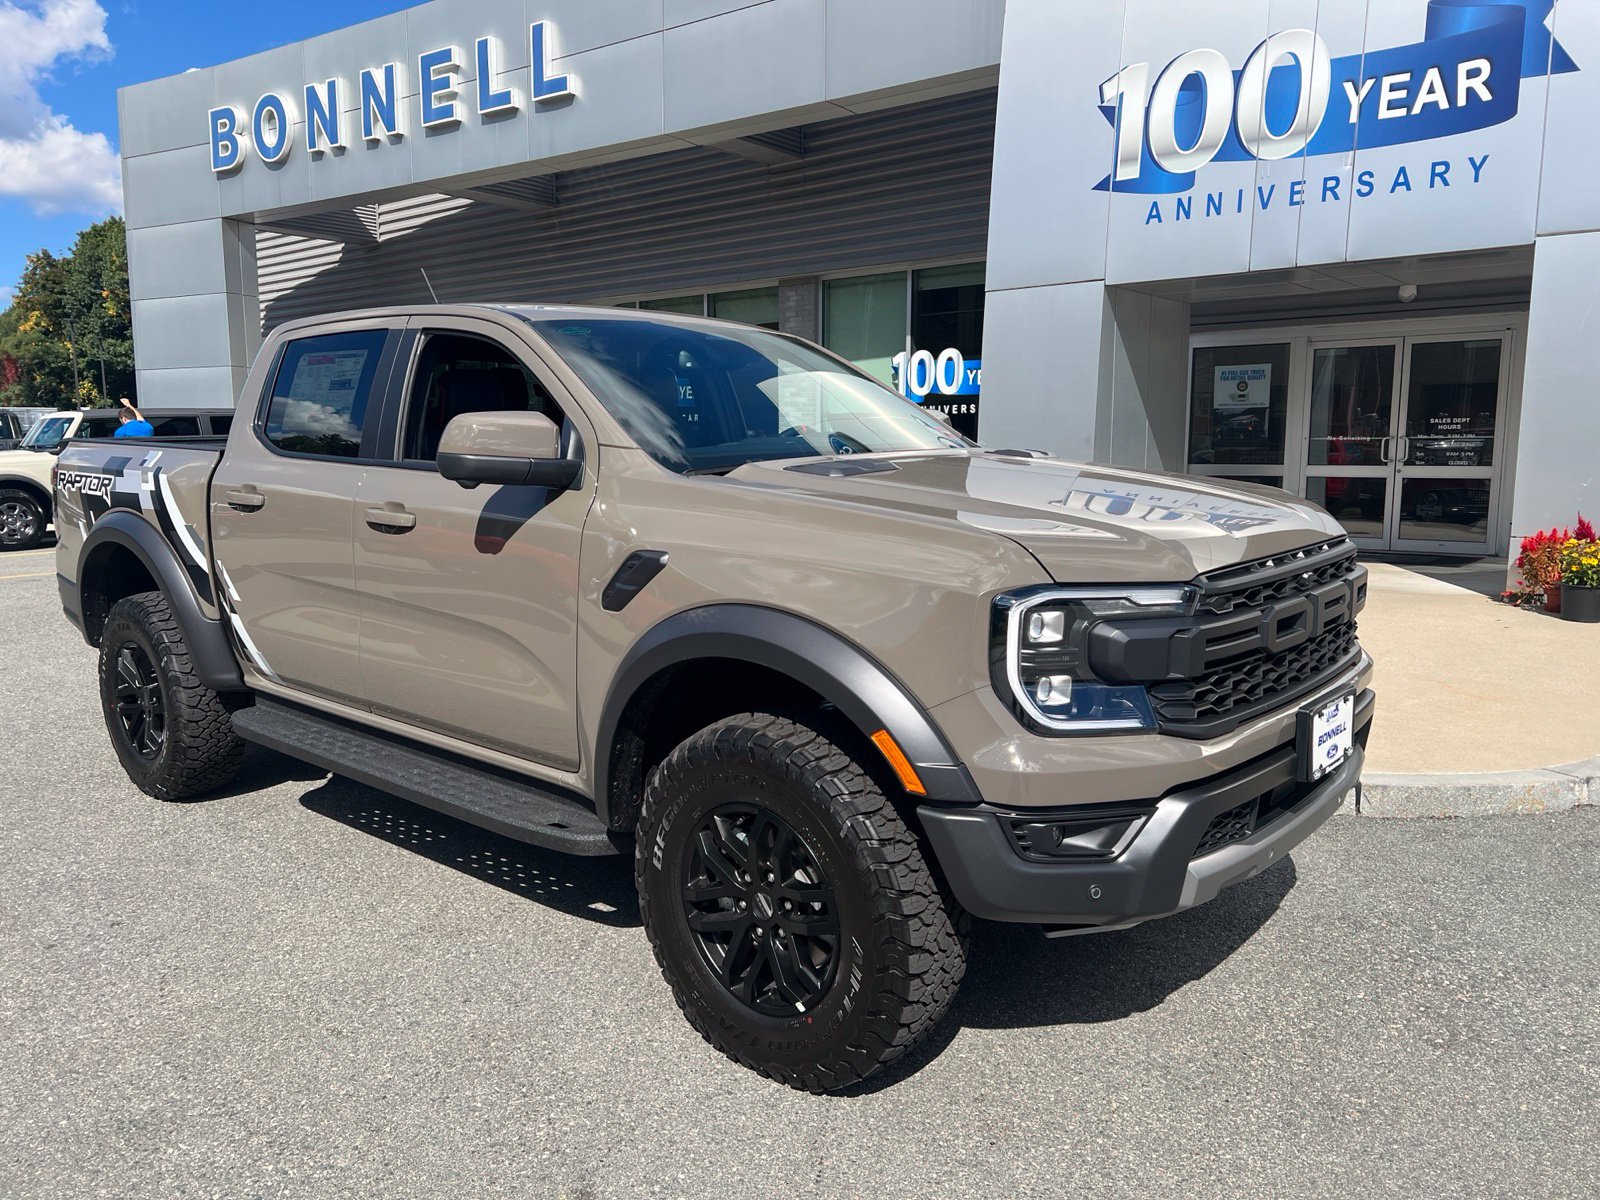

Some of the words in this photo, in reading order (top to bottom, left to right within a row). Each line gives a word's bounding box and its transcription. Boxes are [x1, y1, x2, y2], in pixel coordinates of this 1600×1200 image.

[208, 19, 576, 172] BONNELL
[1100, 28, 1331, 182] 100
[1342, 57, 1493, 124] YEAR
[1145, 154, 1490, 226] ANNIVERSARY
[892, 347, 964, 396] 100
[57, 471, 116, 507] RAPTOR
[1196, 565, 1368, 676] FORD
[1318, 722, 1347, 747] BONNELL
